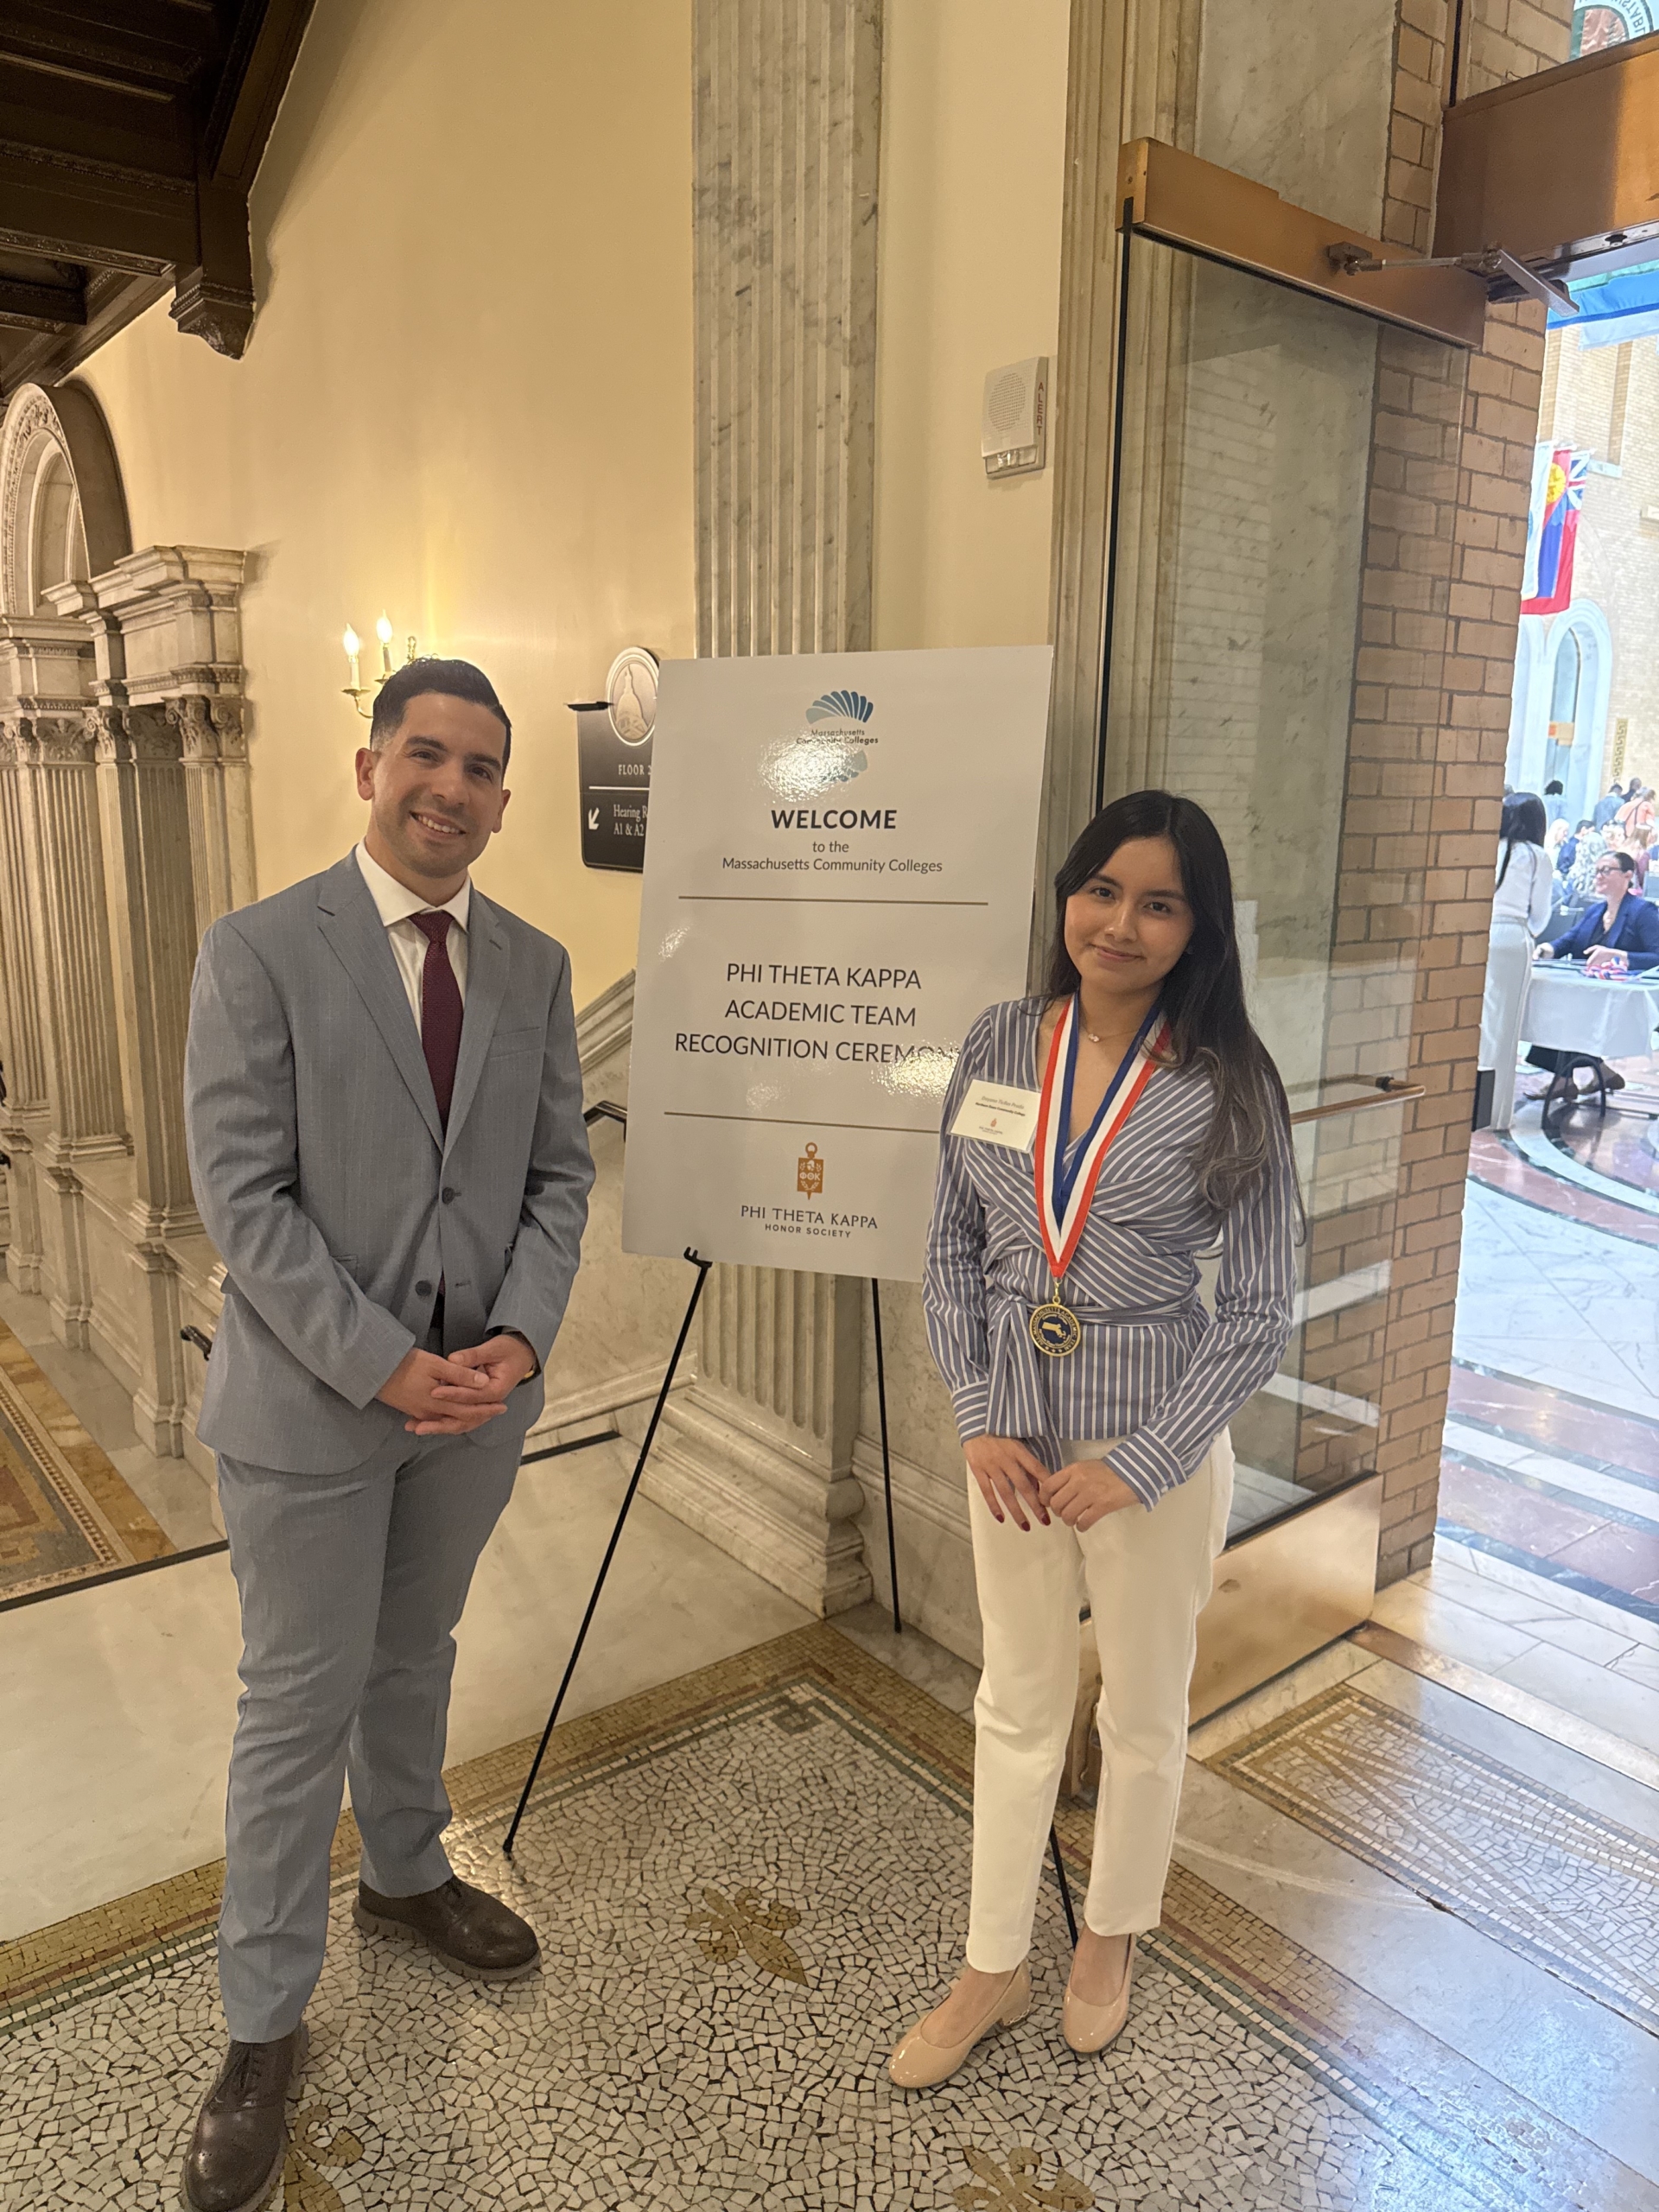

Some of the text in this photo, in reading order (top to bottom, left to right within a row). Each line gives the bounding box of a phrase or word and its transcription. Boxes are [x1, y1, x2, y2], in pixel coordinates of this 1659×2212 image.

[844, 736, 879, 746] Colleges
[618, 764, 645, 775] FLOOR
[613, 804, 641, 823] Hearing
[771, 810, 898, 830] WELCOME
[613, 823, 645, 837] A1 & A2
[812, 841, 849, 853] to the
[722, 857, 943, 874] Massachusetts Community Colleges
[727, 963, 922, 989] PHI THETA KAPPA
[725, 999, 917, 1027] ACADEMIC TEAM
[675, 1033, 961, 1064] RECOGNITION CEREMON
[741, 1205, 878, 1229] PHI THETA KAPPA
[765, 1224, 851, 1238] HONOR SOCIETY
